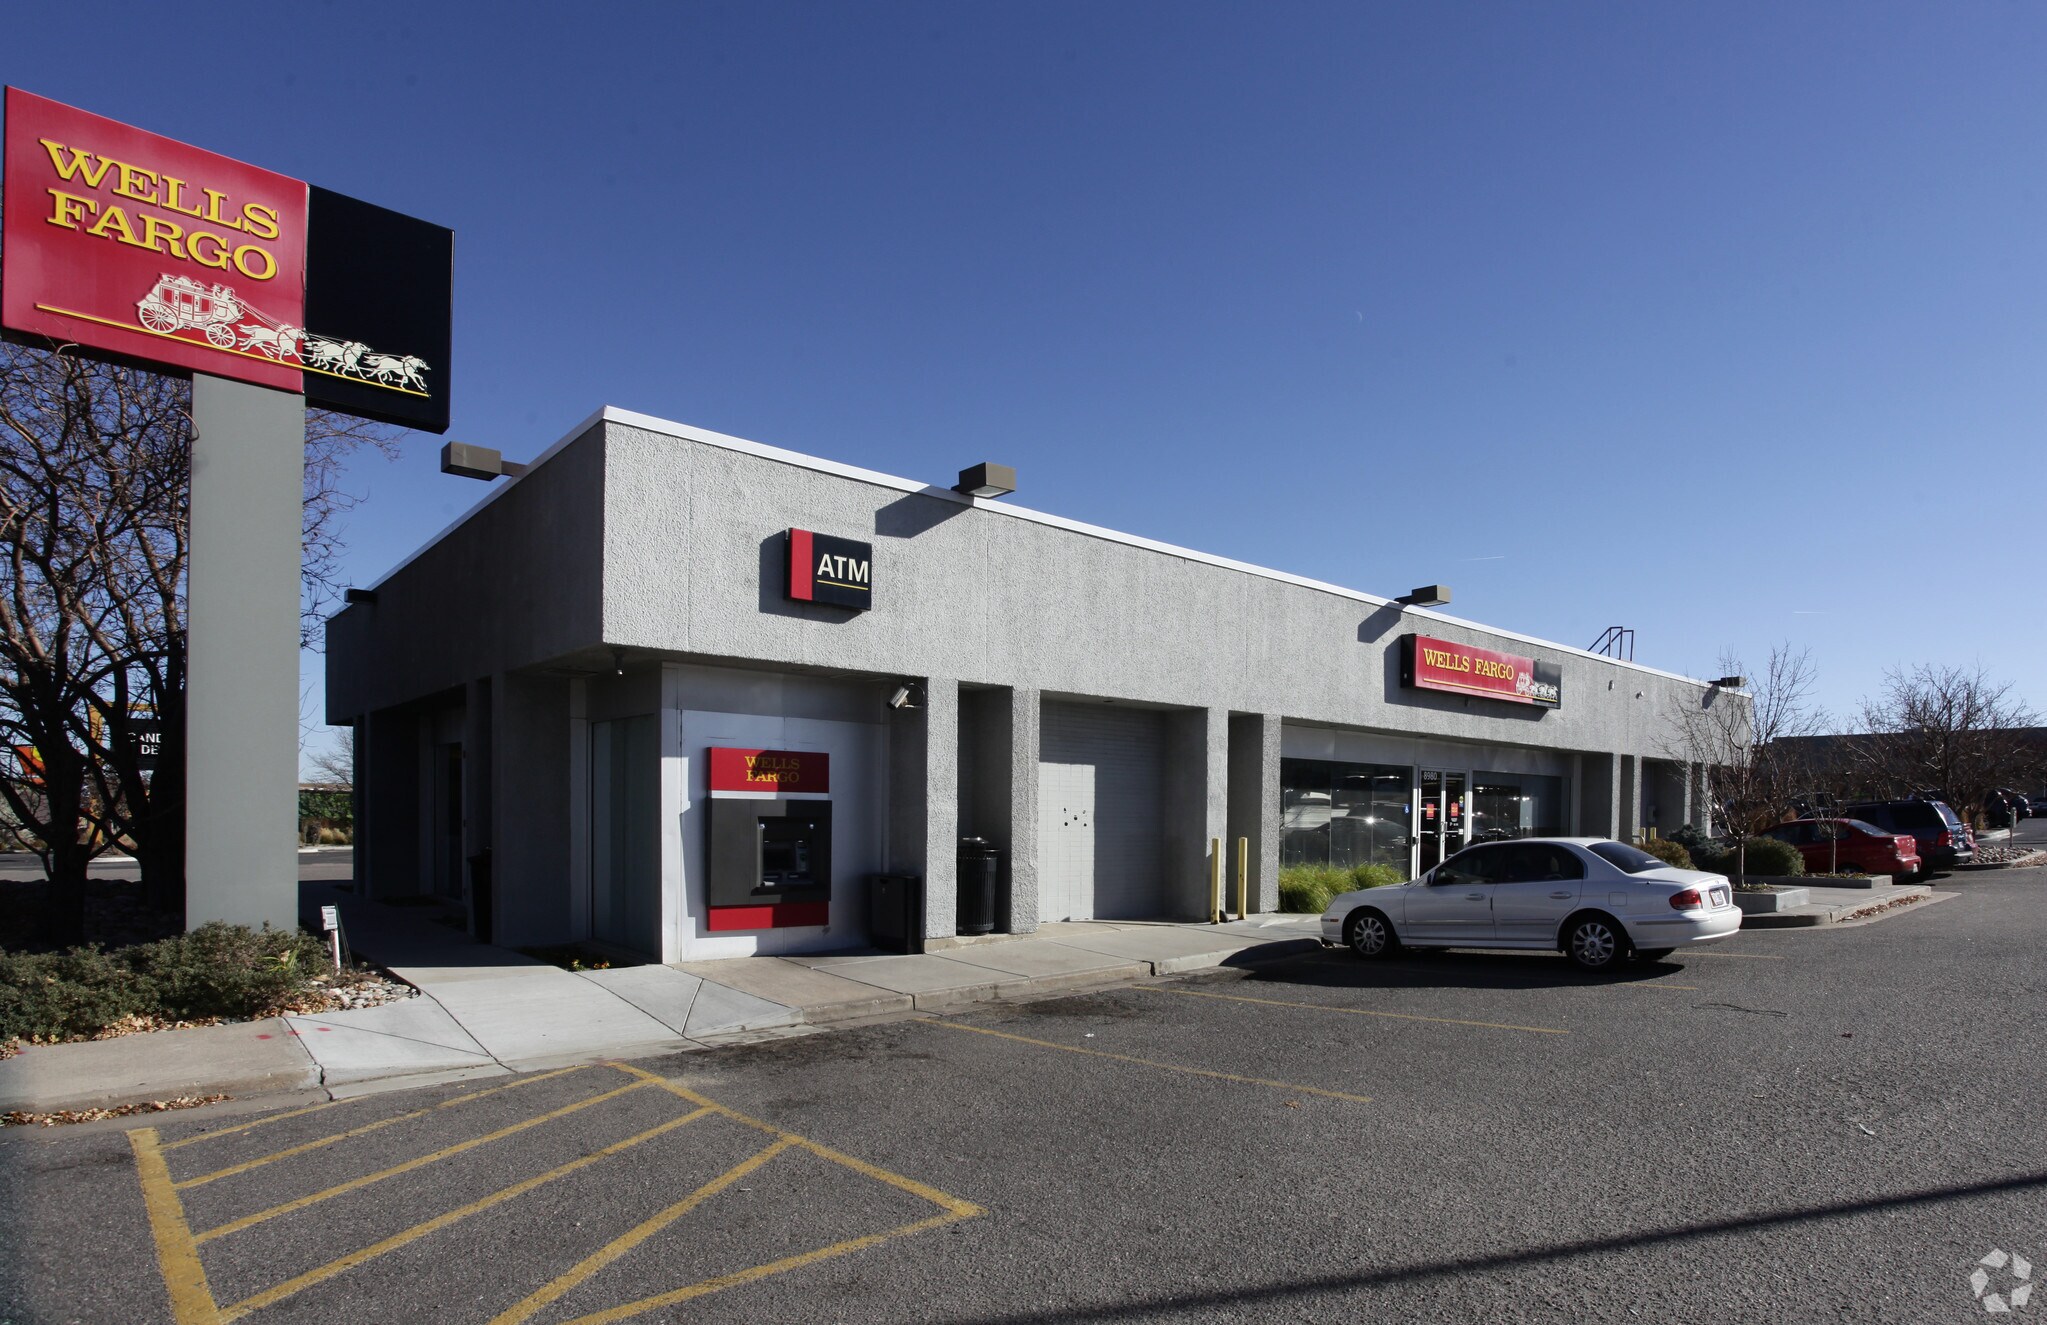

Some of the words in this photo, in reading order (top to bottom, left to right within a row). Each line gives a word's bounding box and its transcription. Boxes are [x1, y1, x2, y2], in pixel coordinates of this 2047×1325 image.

[39, 138, 280, 240] WELLS
[46, 188, 279, 281] FARGO
[817, 553, 869, 583] ATM
[1423, 647, 1470, 673] WELLS
[1474, 657, 1515, 681] FARGO
[744, 755, 800, 770] WELLS
[745, 769, 800, 783] FARGO
